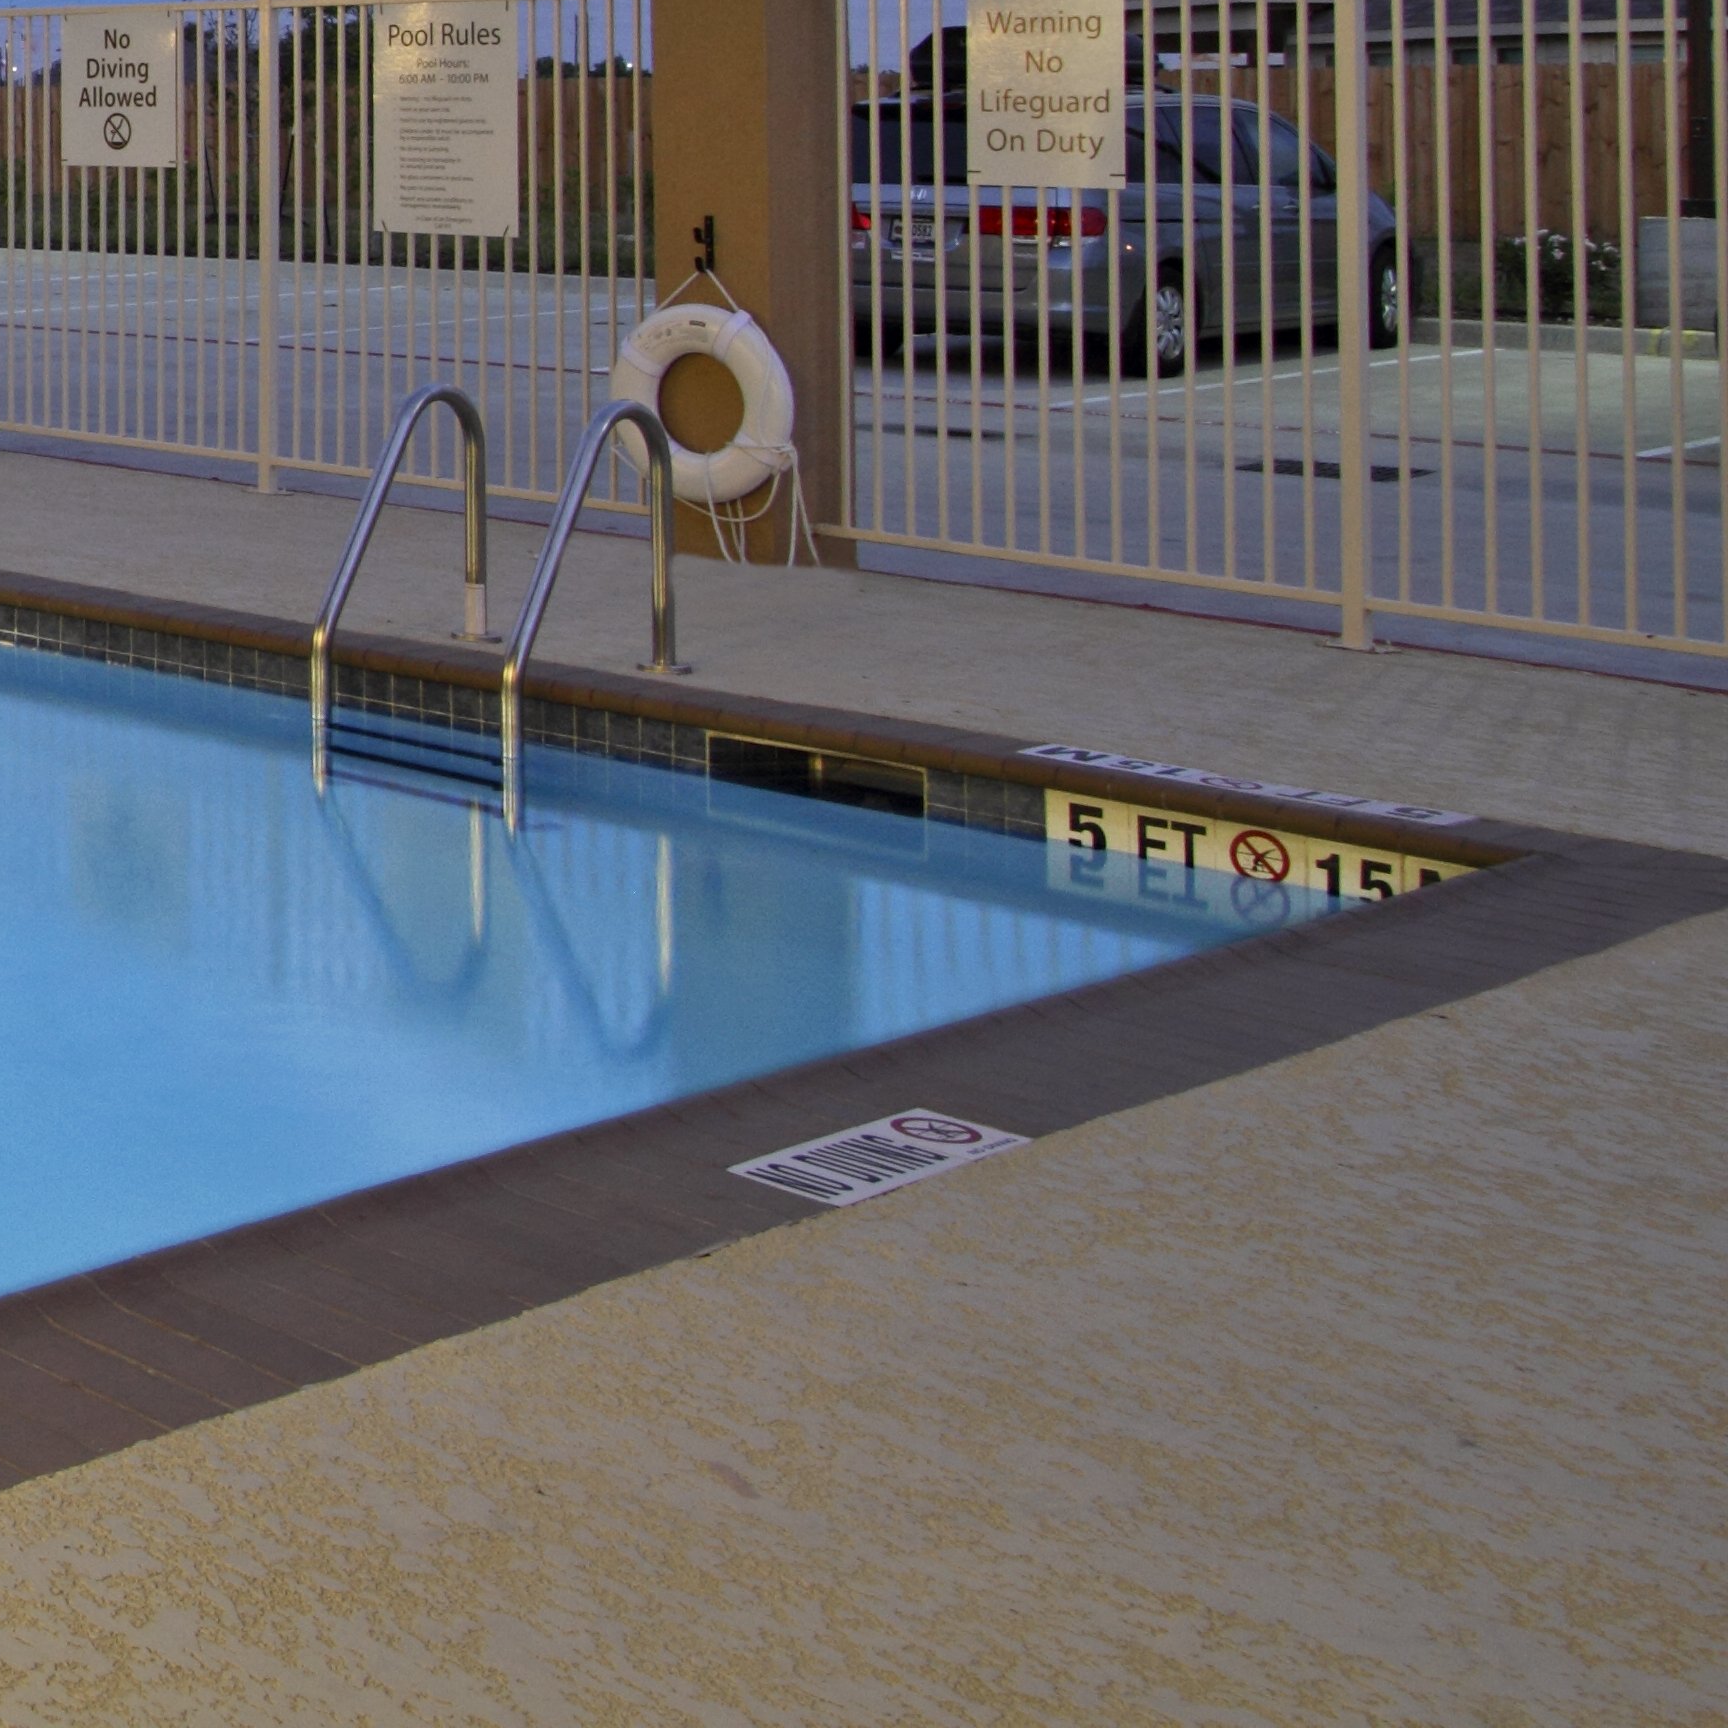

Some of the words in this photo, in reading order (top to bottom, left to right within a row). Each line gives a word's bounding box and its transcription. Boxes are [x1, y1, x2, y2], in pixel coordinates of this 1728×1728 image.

[388, 22, 433, 47] Pool
[441, 21, 501, 46] Rules
[986, 11, 1101, 39] Warning
[104, 29, 130, 49] No
[86, 58, 149, 83] Diving
[416, 58, 437, 68] Pool
[439, 58, 470, 68] Hours:
[1025, 50, 1063, 73] No
[421, 74, 436, 84] AM
[447, 74, 471, 84] 10:00
[473, 73, 489, 84] PM
[78, 85, 157, 107] Allowed
[980, 88, 1110, 119] Lifeguard
[986, 128, 1025, 152] On
[1037, 129, 1104, 160] Duty
[1276, 791, 1371, 807] FT
[1068, 802, 1107, 850] 5
[1138, 815, 1207, 869] FT
[790, 1134, 950, 1184] DIVING
[746, 1163, 853, 1199] NO
